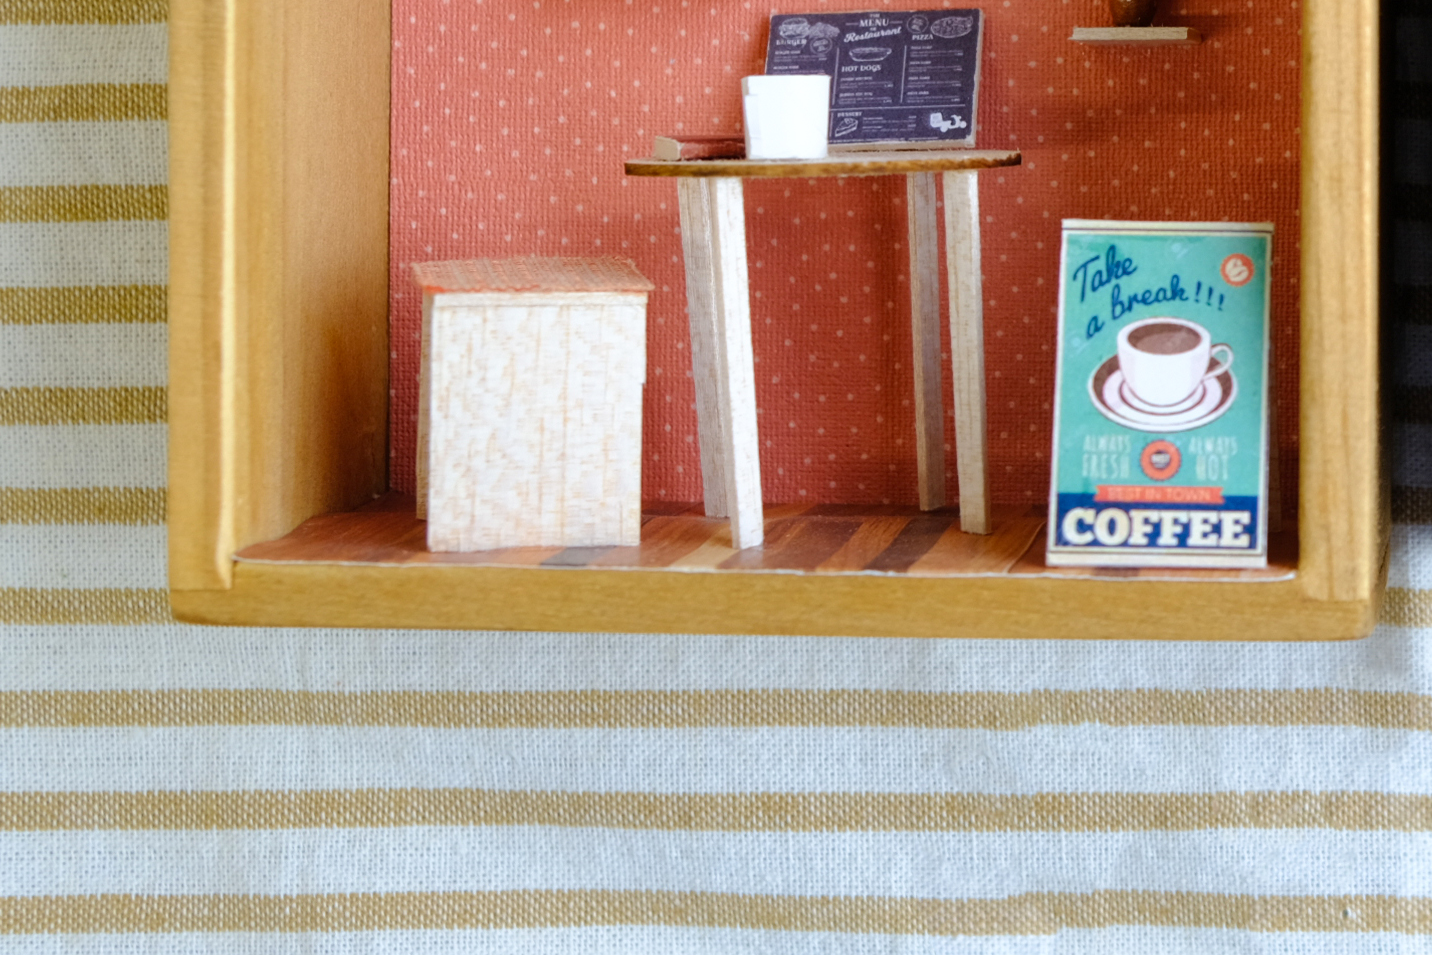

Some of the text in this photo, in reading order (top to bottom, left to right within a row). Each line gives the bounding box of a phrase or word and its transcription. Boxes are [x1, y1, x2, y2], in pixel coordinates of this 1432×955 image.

[859, 18, 889, 27] MENU
[843, 26, 902, 43] Restaurant
[860, 64, 881, 73] DOGS
[1073, 244, 1138, 303] Take
[1086, 315, 1105, 340] a
[1083, 435, 1131, 453] ALWAYS
[1188, 436, 1238, 455] ALWAYS
[1082, 453, 1130, 479] FRESH
[1196, 453, 1229, 481] HOT
[1107, 487, 1142, 500] BEST
[1166, 488, 1211, 501] TOWN
[1060, 507, 1252, 548] COFFEE
